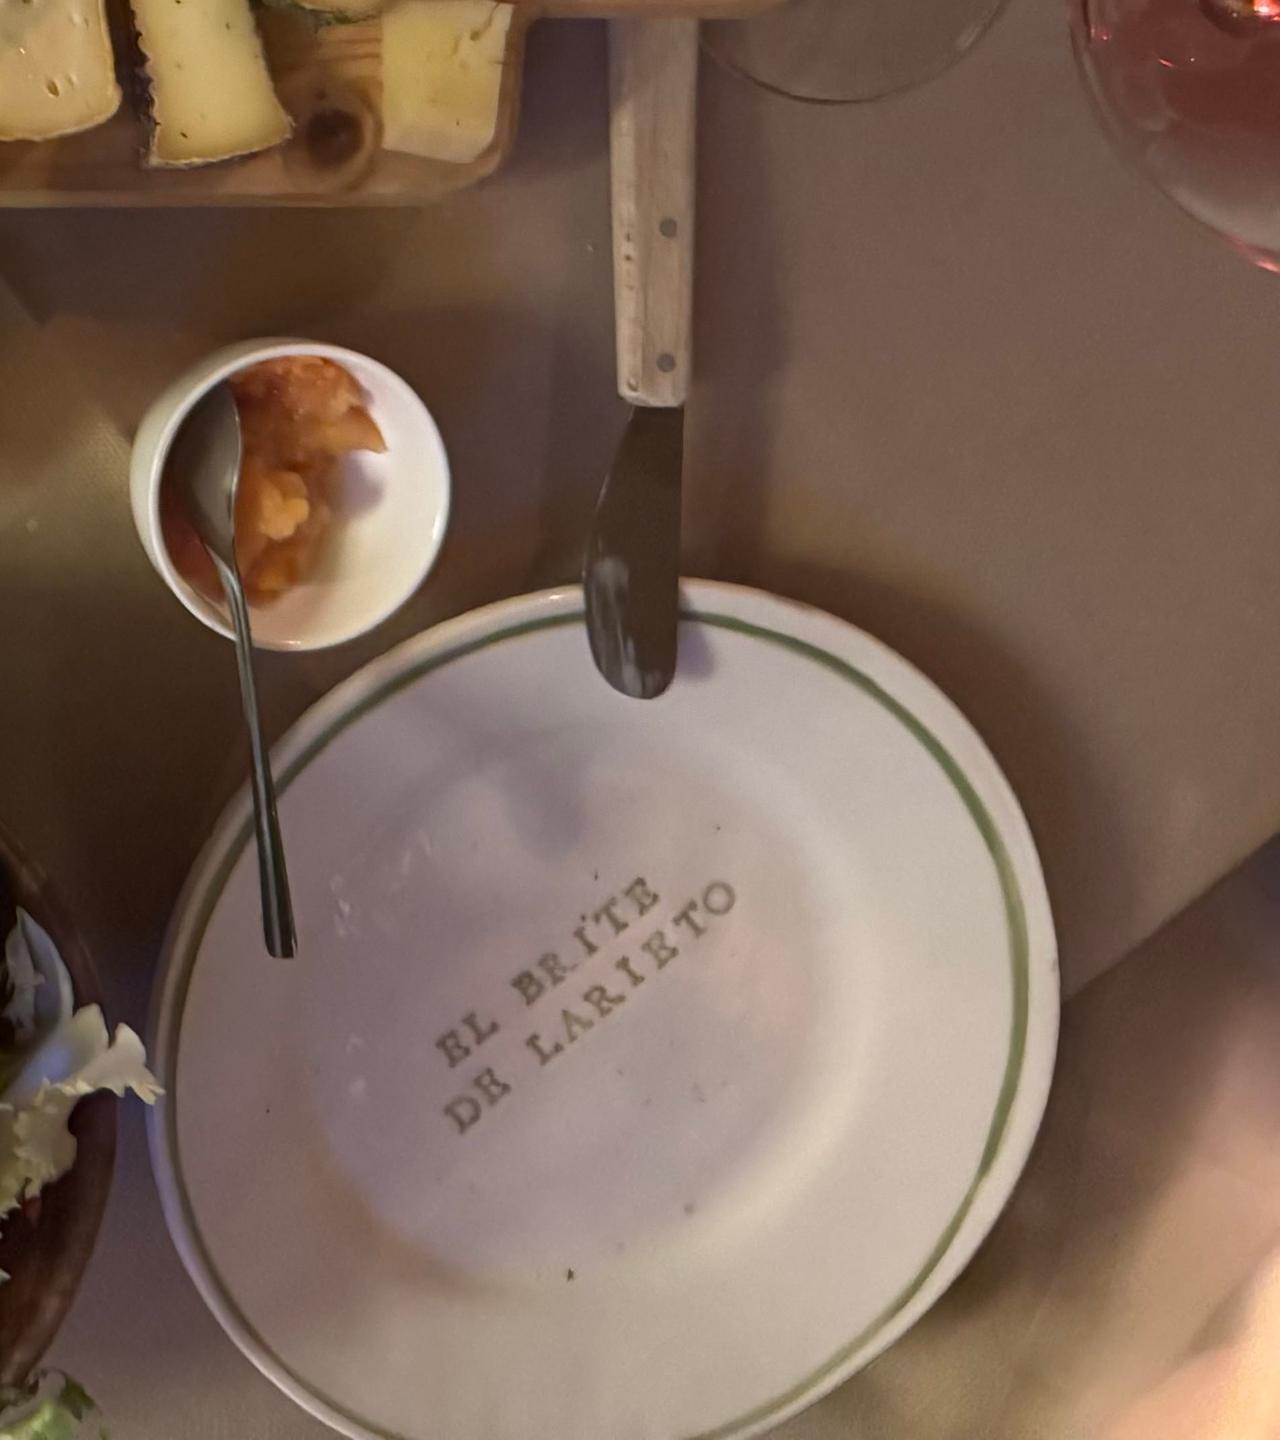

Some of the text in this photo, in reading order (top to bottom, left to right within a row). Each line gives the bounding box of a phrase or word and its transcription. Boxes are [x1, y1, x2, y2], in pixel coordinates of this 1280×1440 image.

[434, 1010, 501, 1070] EL
[443, 880, 737, 1137] DE LARIETO
